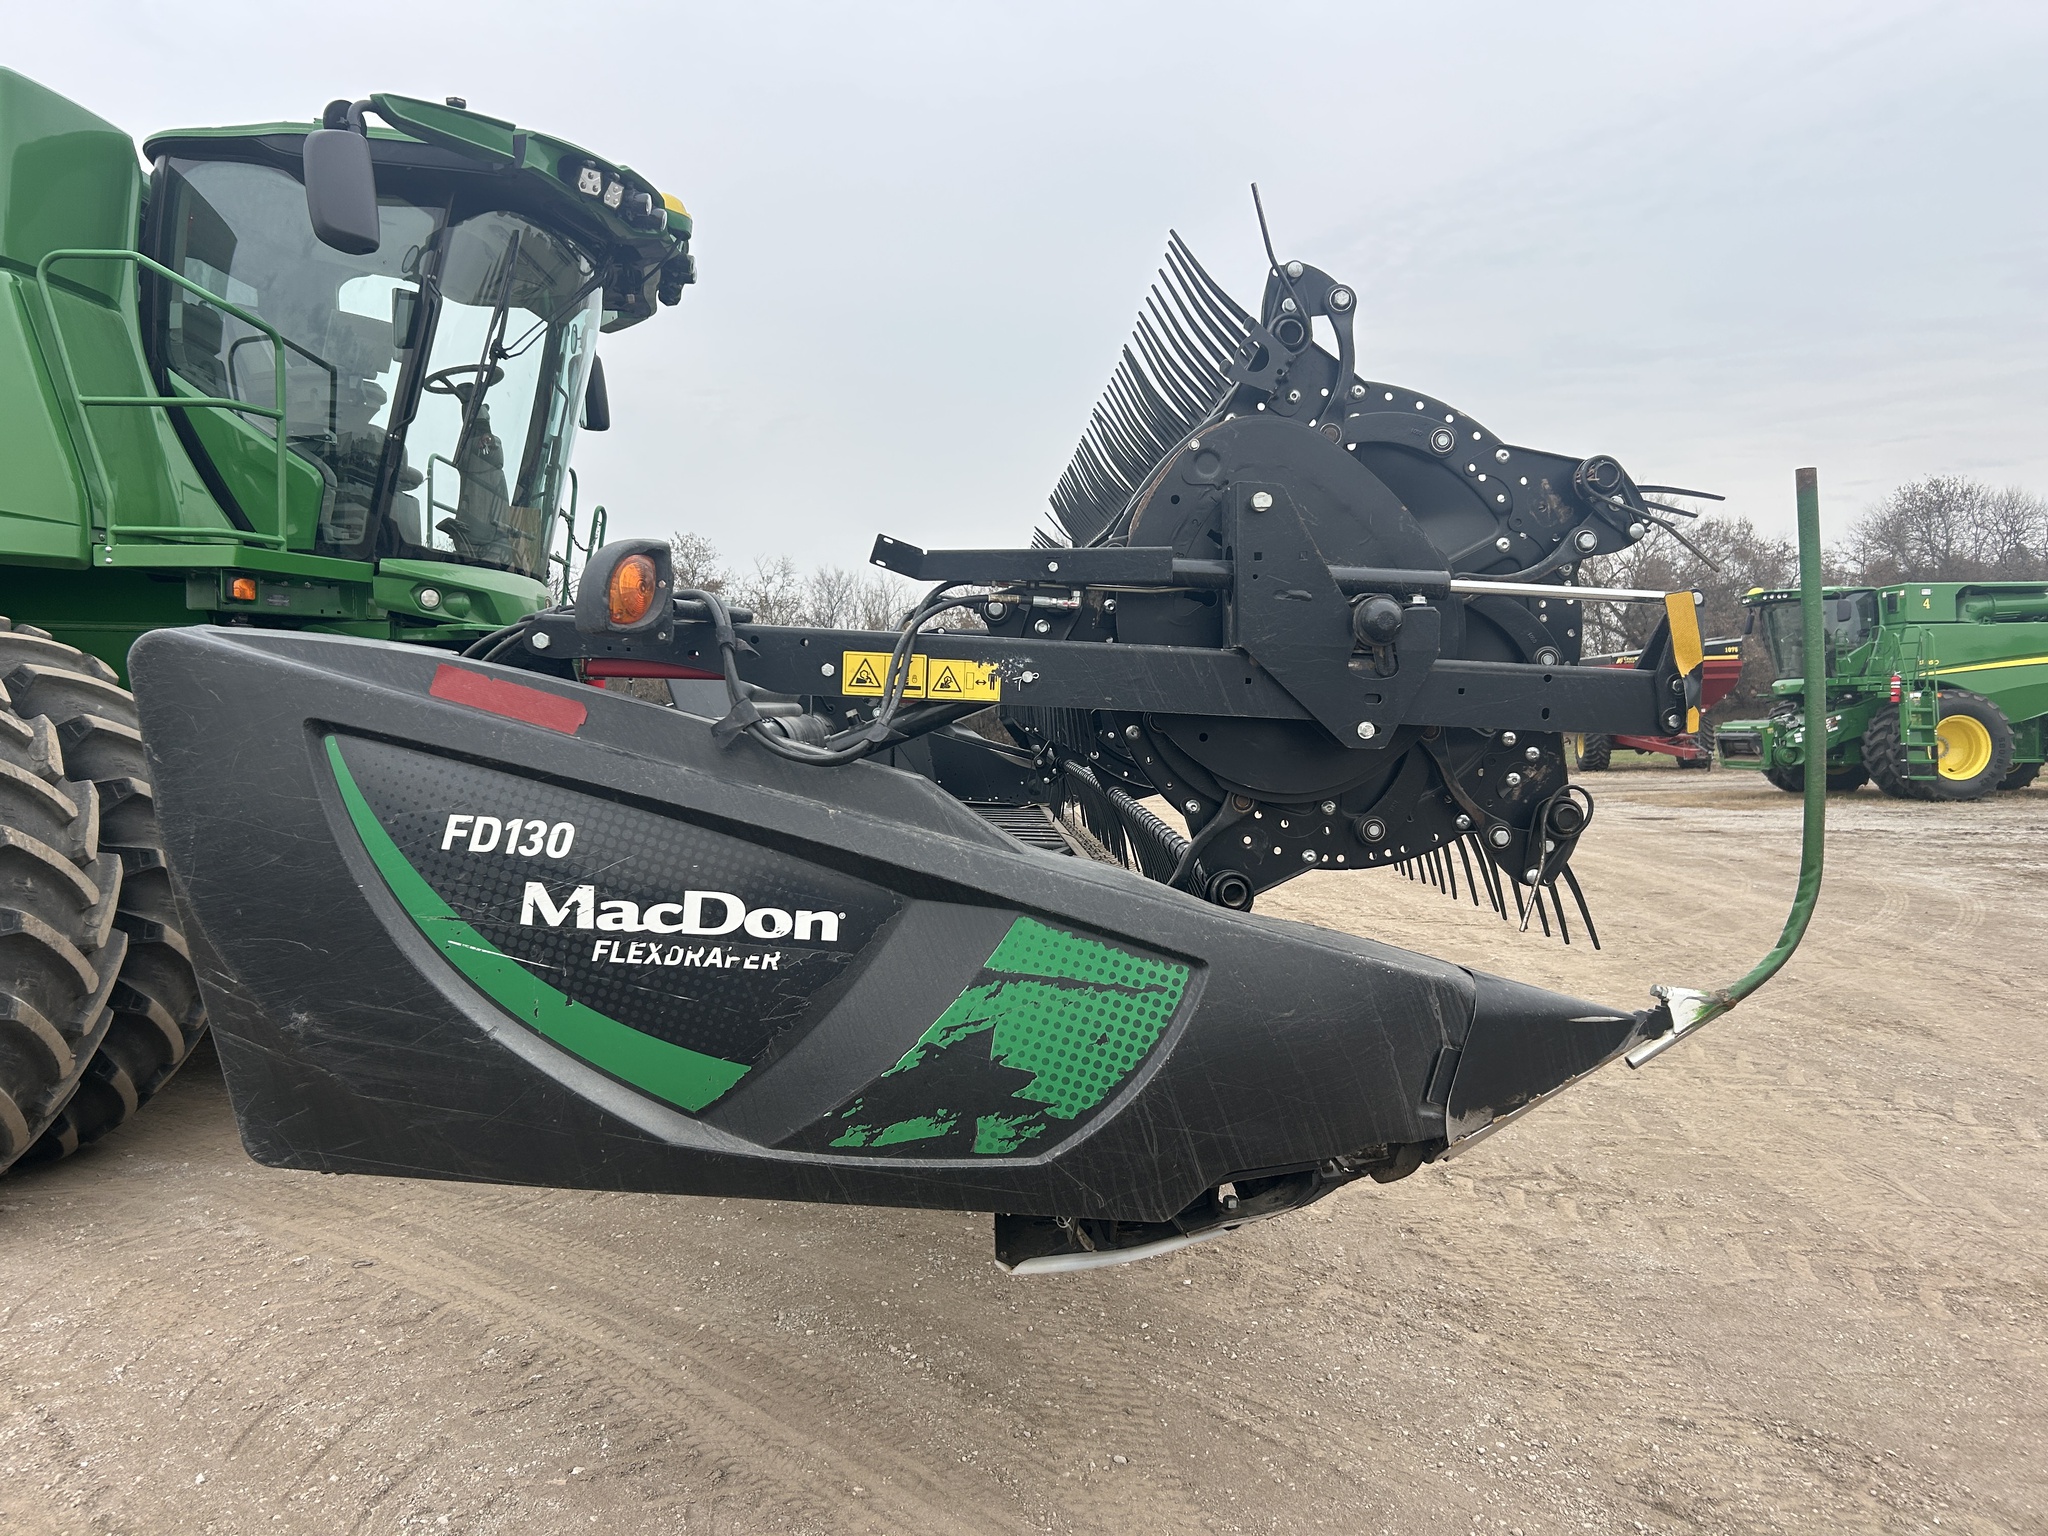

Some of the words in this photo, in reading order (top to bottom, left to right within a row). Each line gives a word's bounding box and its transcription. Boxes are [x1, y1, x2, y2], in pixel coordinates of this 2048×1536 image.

[1922, 598, 1931, 610] 4
[440, 813, 576, 859] FD130
[519, 881, 840, 942] MacDon
